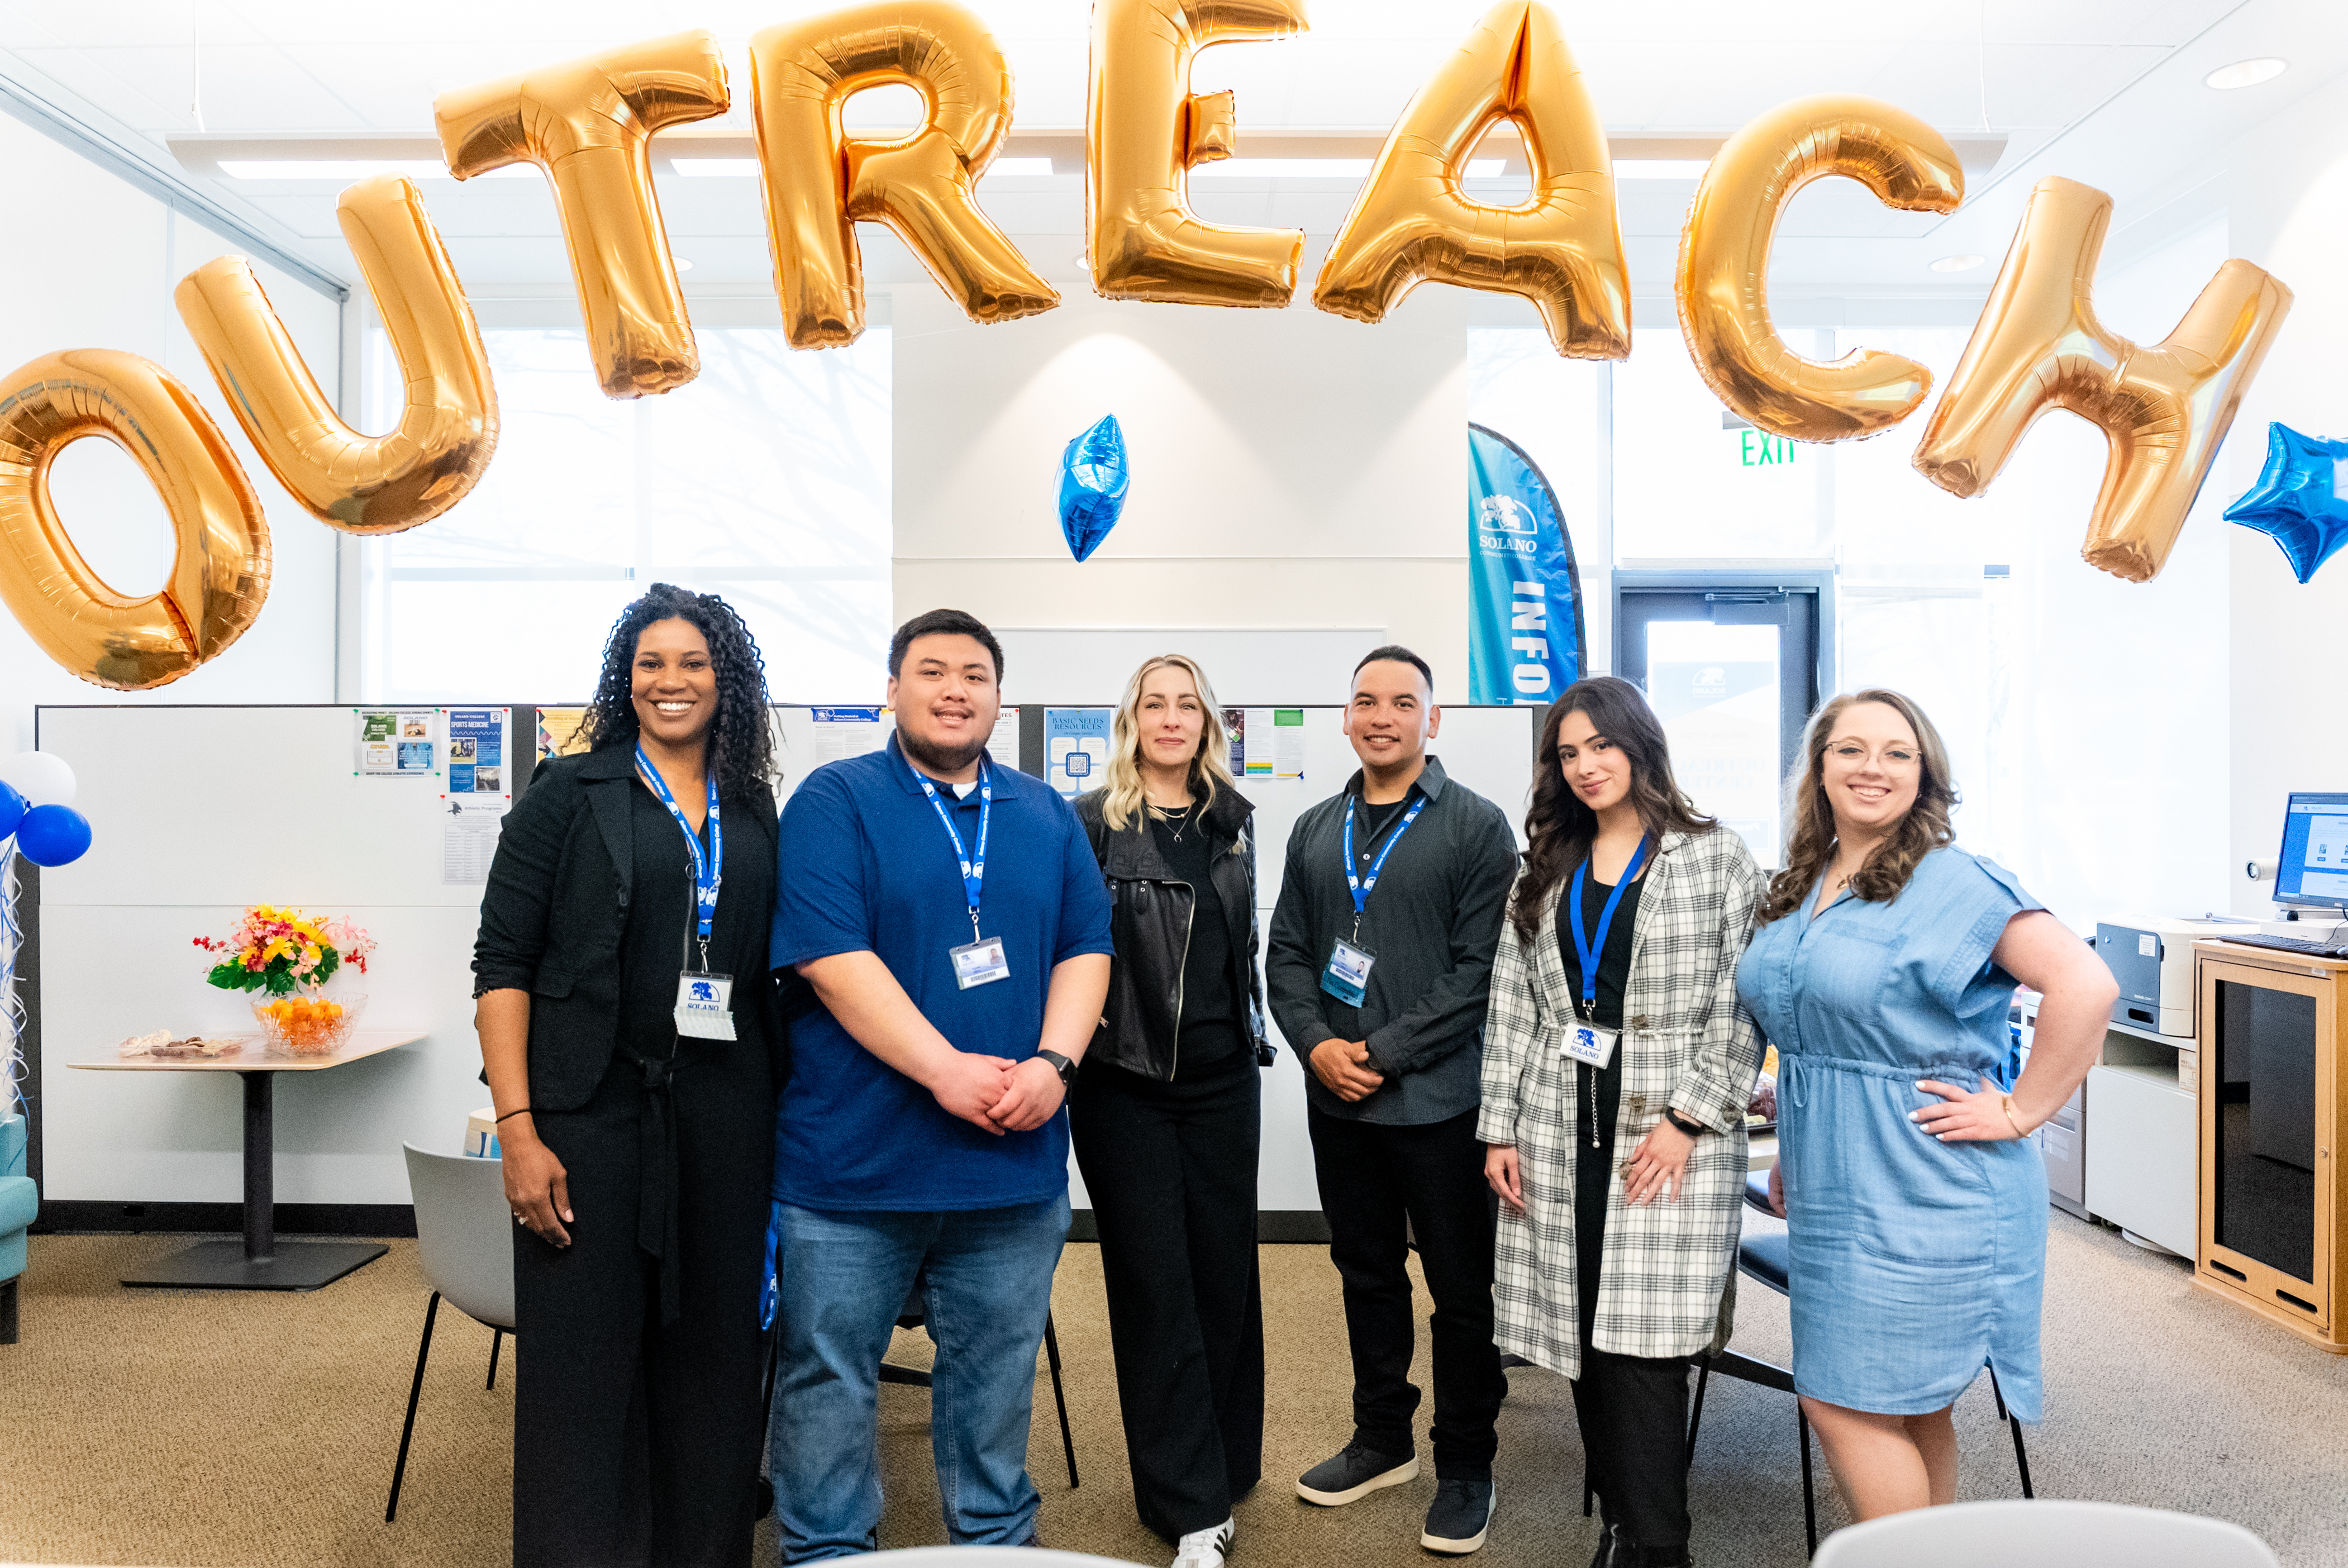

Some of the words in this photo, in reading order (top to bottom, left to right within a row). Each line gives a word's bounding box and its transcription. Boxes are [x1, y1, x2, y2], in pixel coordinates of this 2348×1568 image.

[0, 0, 2293, 690] OUTREACH
[1479, 535, 1537, 553] SOLANO
[1512, 580, 1551, 705] INFO
[688, 1003, 719, 1012] SOLANO
[1570, 1045, 1599, 1060] SOLANO
